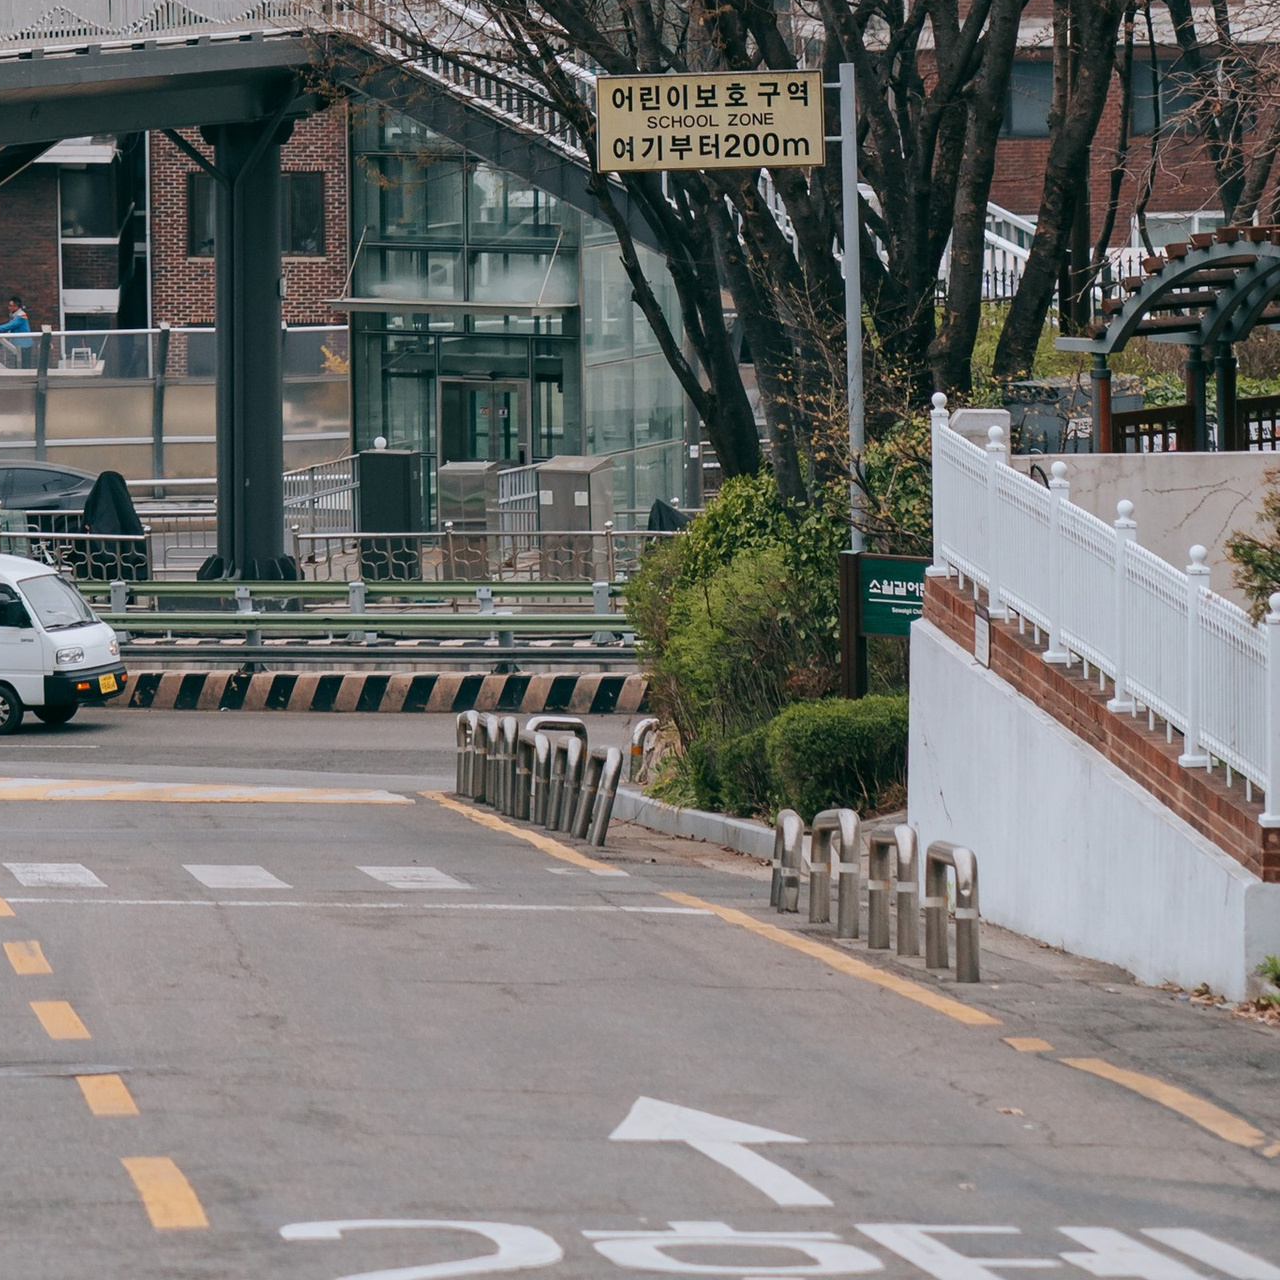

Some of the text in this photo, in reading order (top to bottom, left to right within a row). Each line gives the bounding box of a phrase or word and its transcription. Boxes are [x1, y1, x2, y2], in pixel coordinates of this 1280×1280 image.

[612, 80, 810, 112] 어린이보호구역
[647, 112, 774, 129] SCHOOL ZONE
